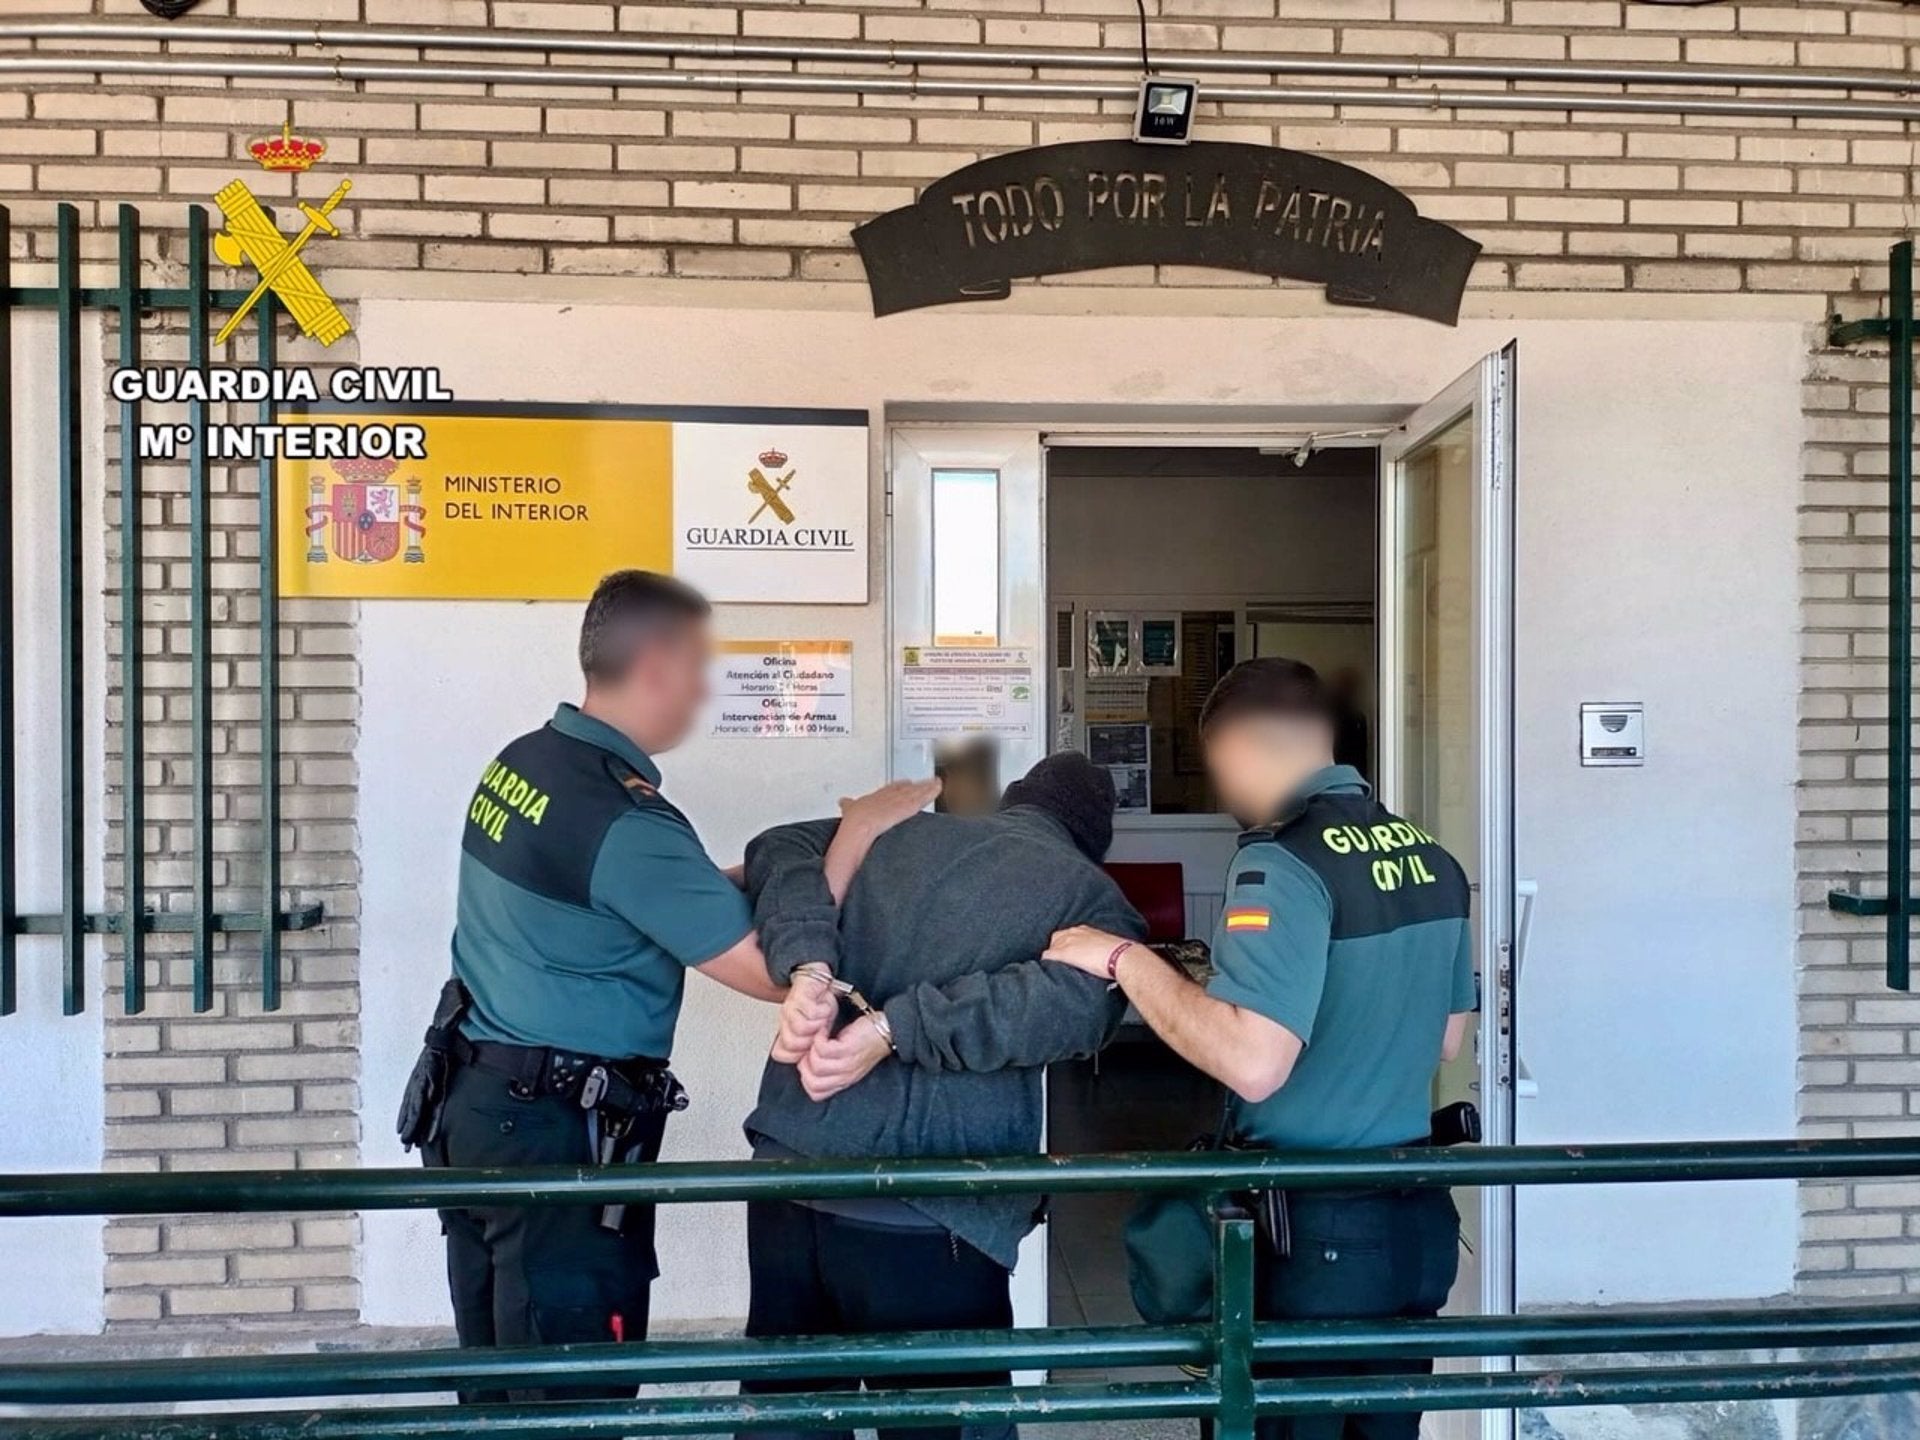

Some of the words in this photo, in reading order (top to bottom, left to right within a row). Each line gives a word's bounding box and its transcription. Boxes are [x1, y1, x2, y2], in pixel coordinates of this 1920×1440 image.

[952, 176, 1063, 248] TODO
[1088, 172, 1168, 227] POR
[1184, 171, 1233, 228] LA
[1252, 180, 1386, 262] PATRIA
[445, 475, 561, 495] MINISTERIO
[445, 502, 483, 520] DEL
[492, 503, 589, 522] INTERIOR
[686, 527, 789, 546] GUARDIA
[794, 529, 854, 547] CIVIL
[763, 657, 797, 666] Oficina
[726, 670, 769, 679] Atención
[783, 670, 835, 679] Cidadano
[793, 683, 818, 691] Horas
[722, 712, 786, 721] Intervención
[788, 712, 801, 721] de
[803, 712, 837, 721] Armas
[752, 724, 762, 733] de
[482, 760, 550, 826] UARDIA
[470, 793, 510, 843] CIVIL
[1372, 855, 1437, 892] CIVIL
